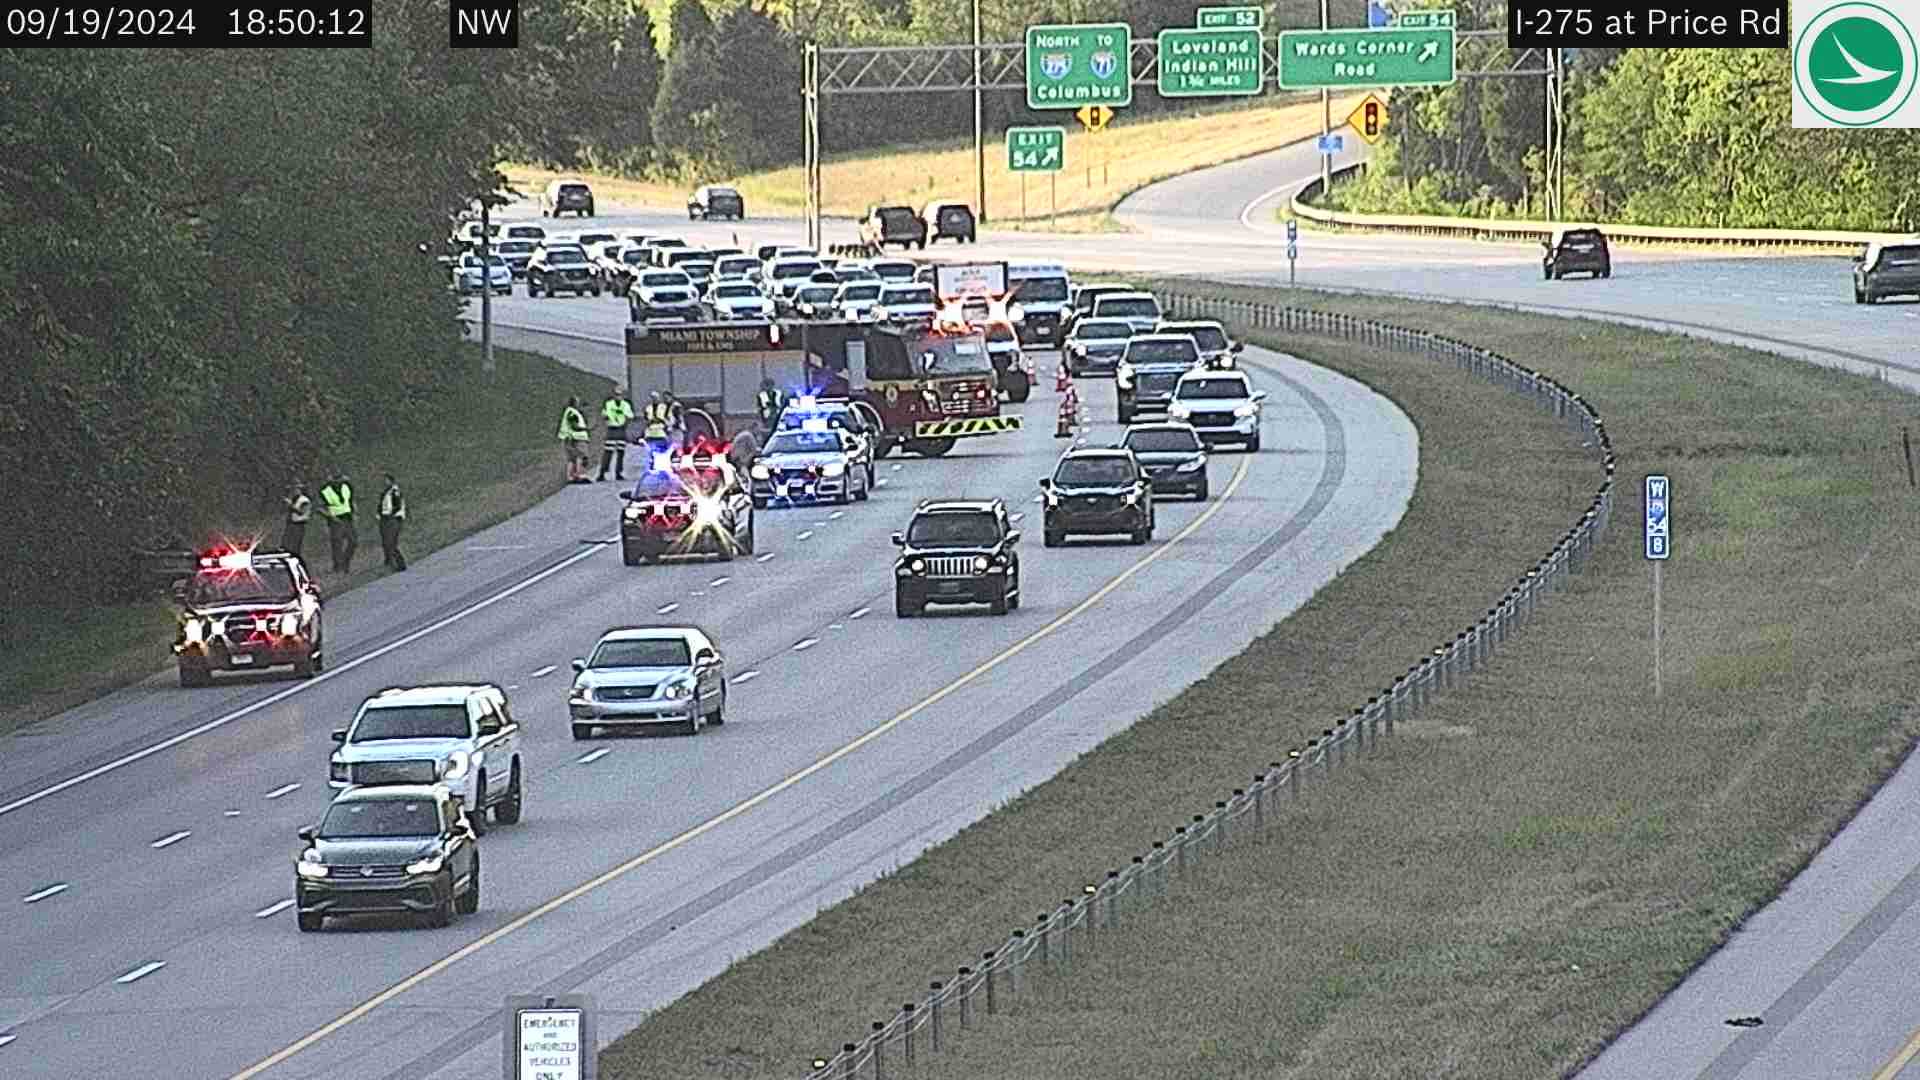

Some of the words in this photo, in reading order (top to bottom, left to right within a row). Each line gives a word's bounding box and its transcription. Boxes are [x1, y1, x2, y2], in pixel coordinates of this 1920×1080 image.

[1204, 14, 1227, 25] EXIT
[1236, 12, 1255, 26] 52
[1403, 15, 1425, 26] EXIT
[1430, 14, 1450, 26] 54
[1036, 34, 1080, 49] NORTH
[1097, 34, 1113, 47] TO
[1172, 40, 1249, 55] Loveland
[1295, 42, 1347, 57] Wards
[1356, 40, 1414, 55] Corner
[1164, 60, 1218, 74] Indian
[1226, 58, 1256, 73] Hill
[1334, 62, 1376, 77] Road
[1037, 84, 1121, 100] Columbus
[1018, 133, 1053, 146] EXIT
[1013, 150, 1037, 168] 54
[659, 330, 697, 342] MIAMI
[699, 329, 760, 341] TOWNSHIP
[1650, 481, 1664, 496] W
[523, 1042, 577, 1052] AUTHORIZED
